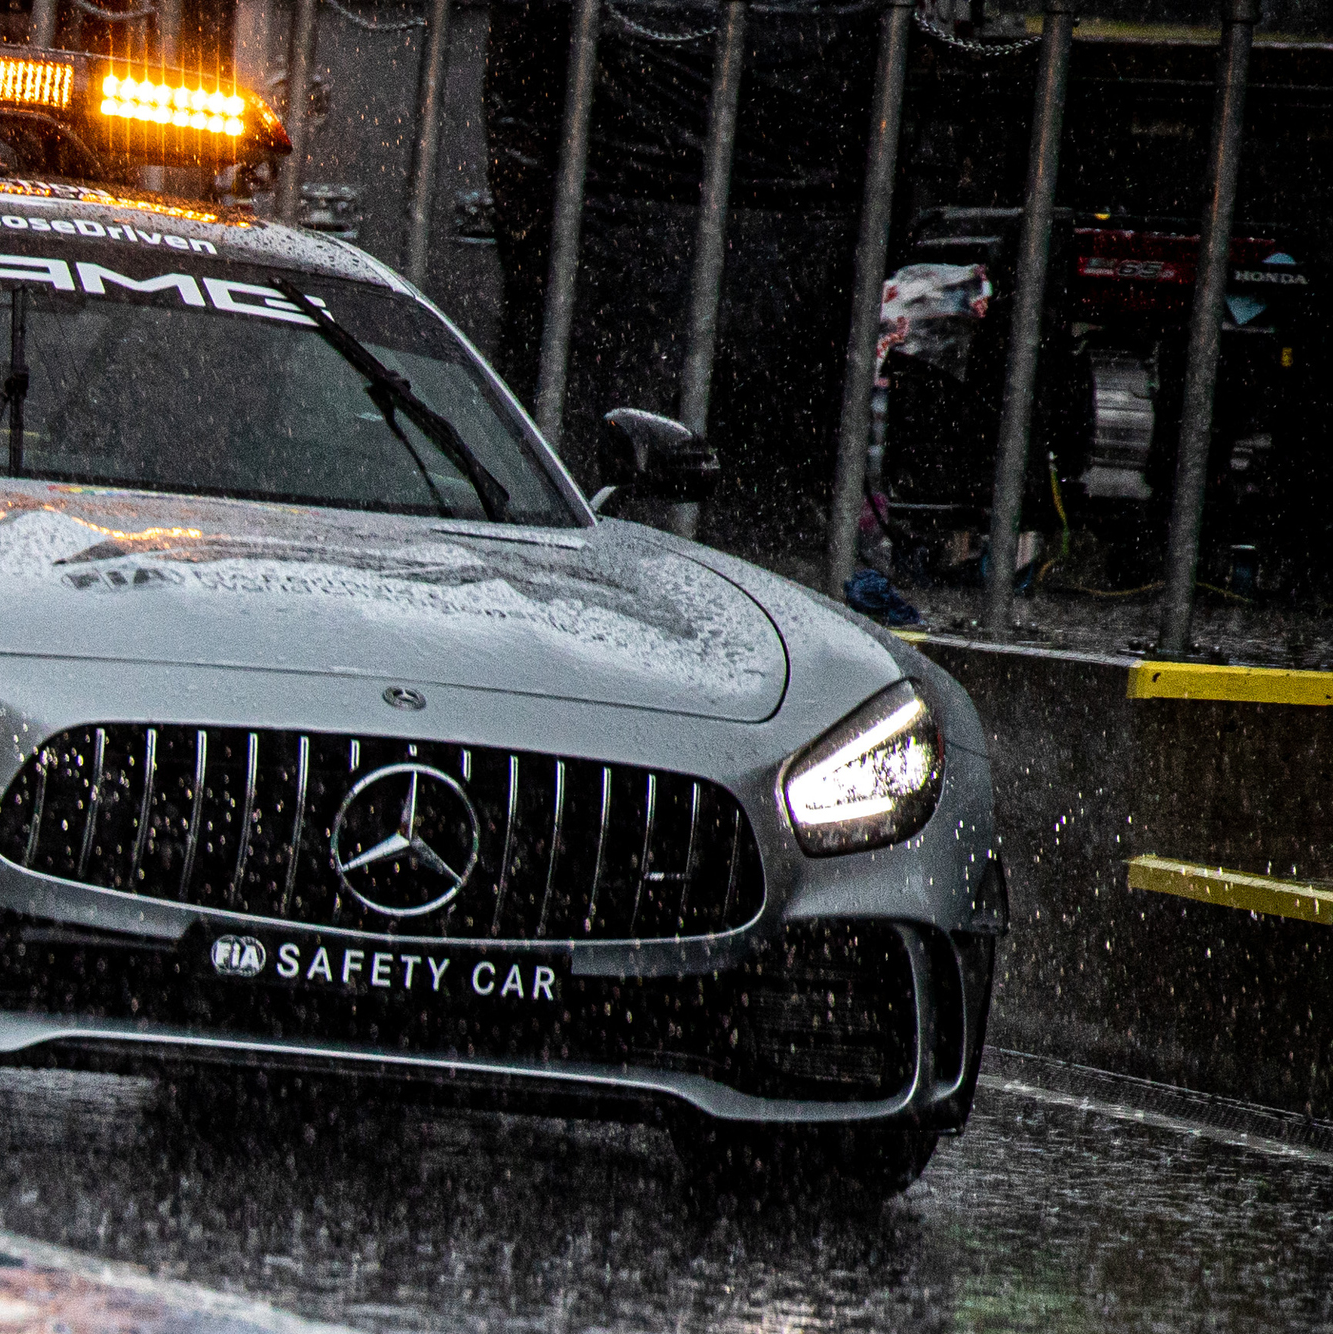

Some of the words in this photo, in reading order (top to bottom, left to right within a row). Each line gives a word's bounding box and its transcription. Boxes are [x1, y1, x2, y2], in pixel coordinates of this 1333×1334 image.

[1234, 269, 1309, 286] HONDA
[276, 942, 451, 992] SAFETY
[471, 960, 556, 1001] CAR
